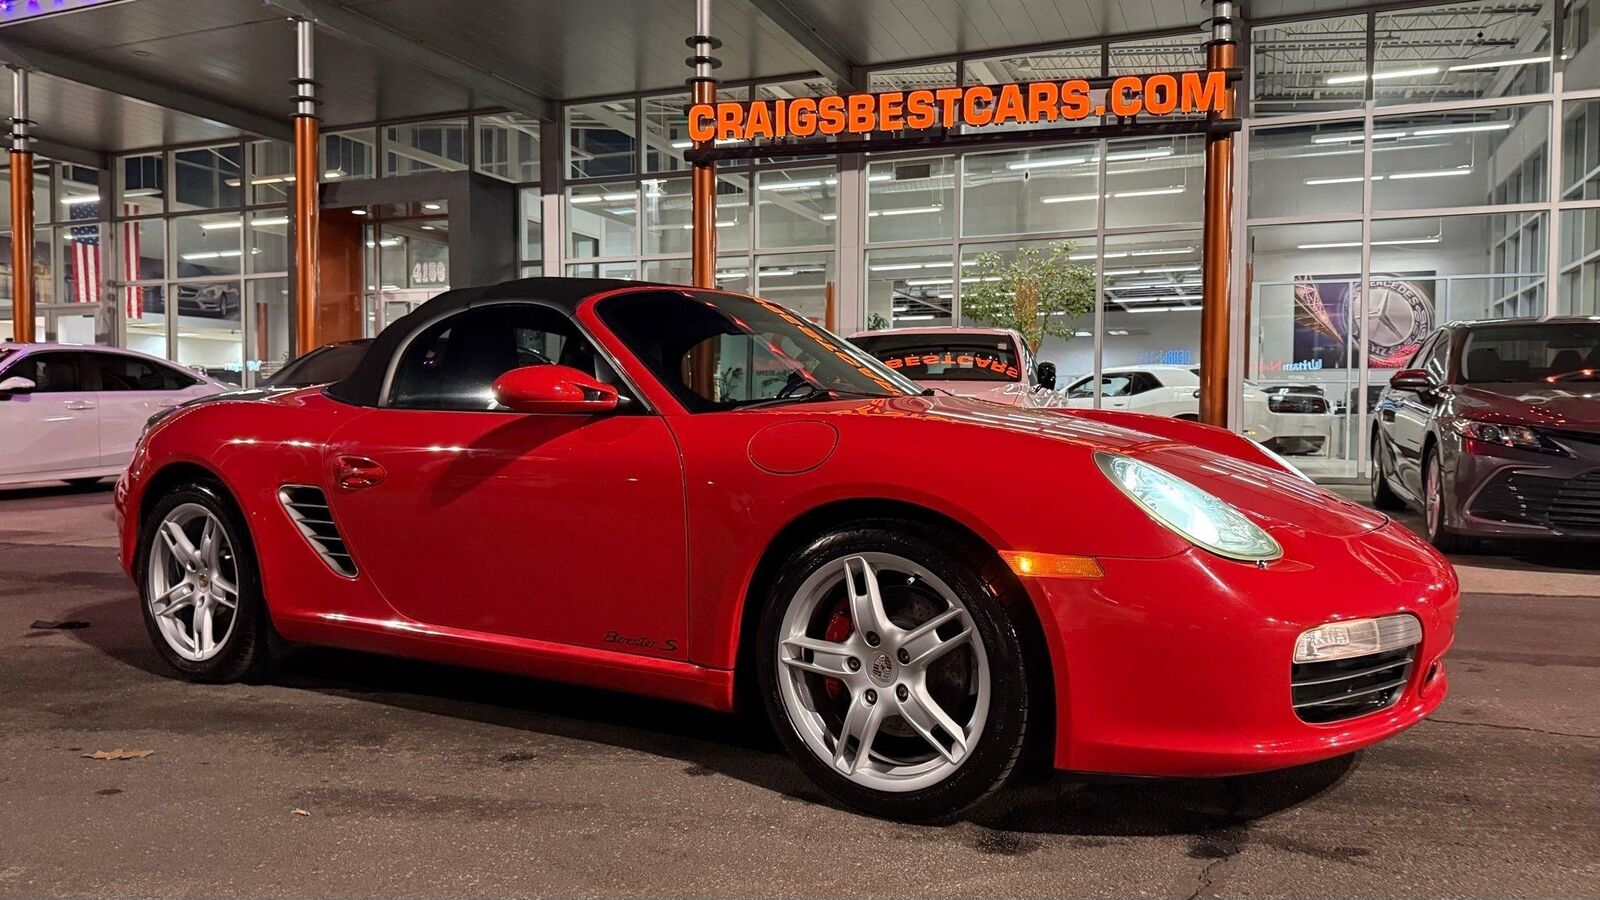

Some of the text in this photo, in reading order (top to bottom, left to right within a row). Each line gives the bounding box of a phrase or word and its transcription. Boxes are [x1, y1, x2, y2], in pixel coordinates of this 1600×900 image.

[688, 72, 1226, 142] CRAIGSBESTCARS.COM
[1369, 281, 1421, 306] ERCEDES
[660, 639, 679, 652] S
